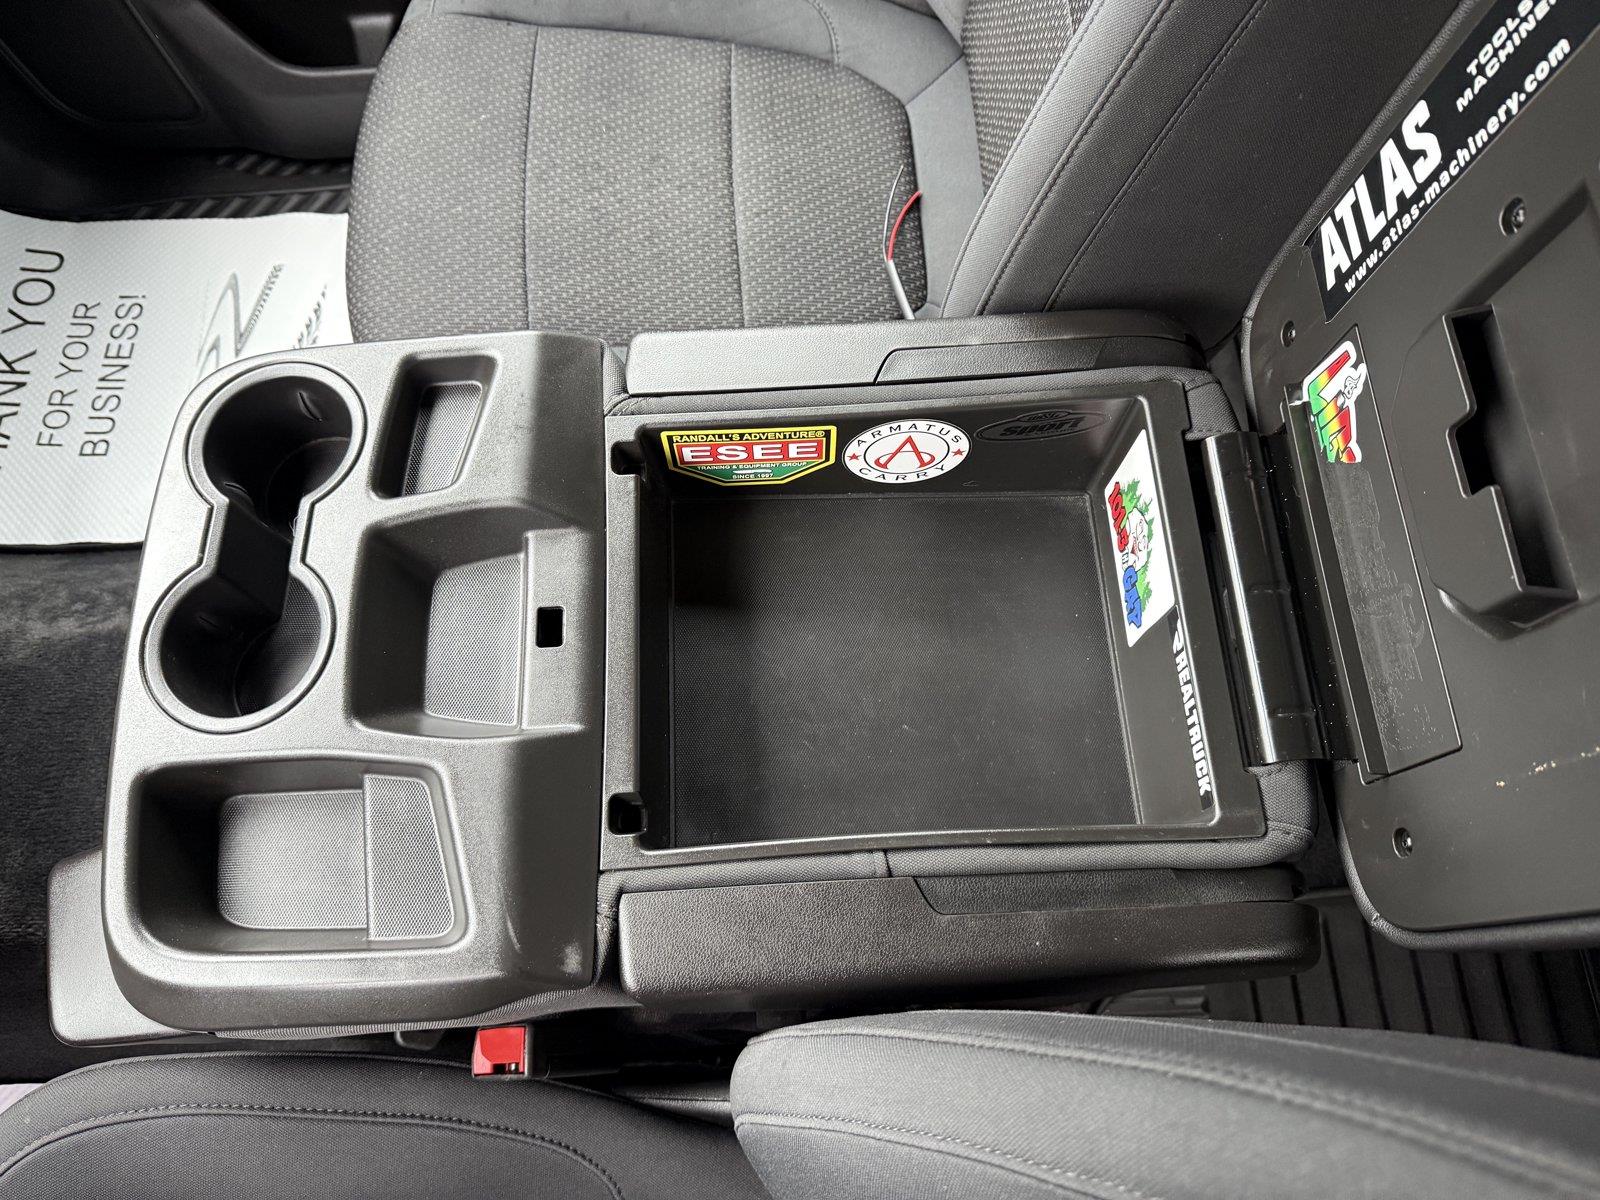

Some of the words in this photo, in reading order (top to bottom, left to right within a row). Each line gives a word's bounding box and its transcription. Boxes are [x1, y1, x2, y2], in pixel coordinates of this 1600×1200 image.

[1320, 99, 1442, 291] ATLAS
[1344, 38, 1571, 293] www.atlas-machinery.com
[0, 247, 65, 334] YOU
[54, 301, 101, 380] YOUR
[78, 295, 147, 458] BUSINESS!
[36, 388, 78, 447] FOR
[672, 432, 740, 443] RANDALL'S
[681, 442, 819, 463] ESEE
[857, 423, 962, 447] ARMATUS
[859, 464, 945, 481] CARRY
[1175, 649, 1212, 797] REALTRUCK
